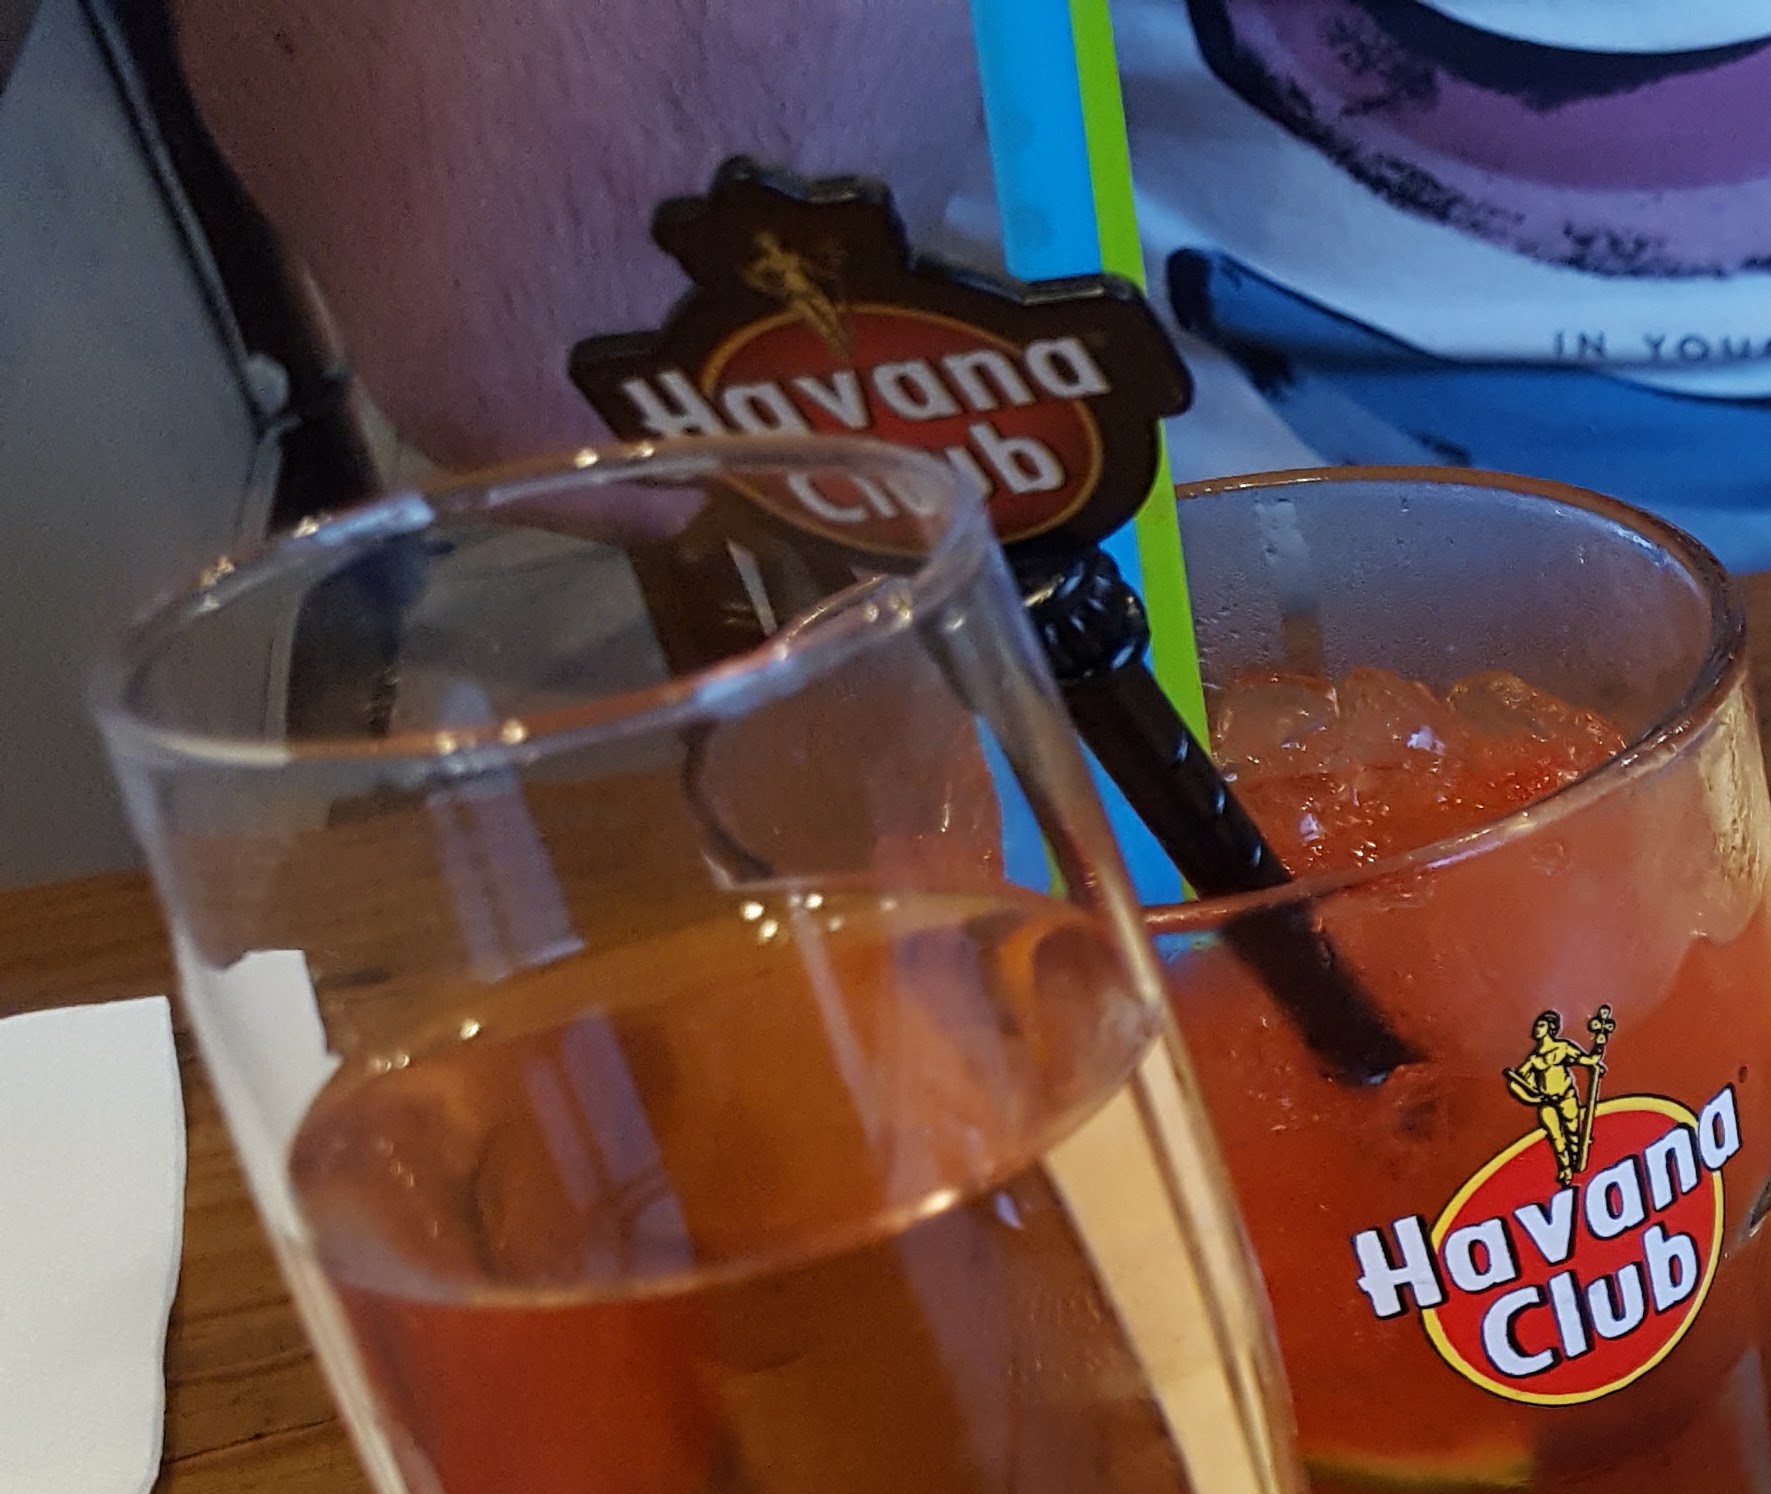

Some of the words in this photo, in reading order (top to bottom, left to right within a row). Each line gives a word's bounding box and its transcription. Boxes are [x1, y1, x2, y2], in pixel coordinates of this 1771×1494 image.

[622, 338, 1110, 438] Havana
[1554, 329, 1607, 363] IN
[1352, 1084, 1741, 1319] Havana
[1480, 1224, 1700, 1379] Club
